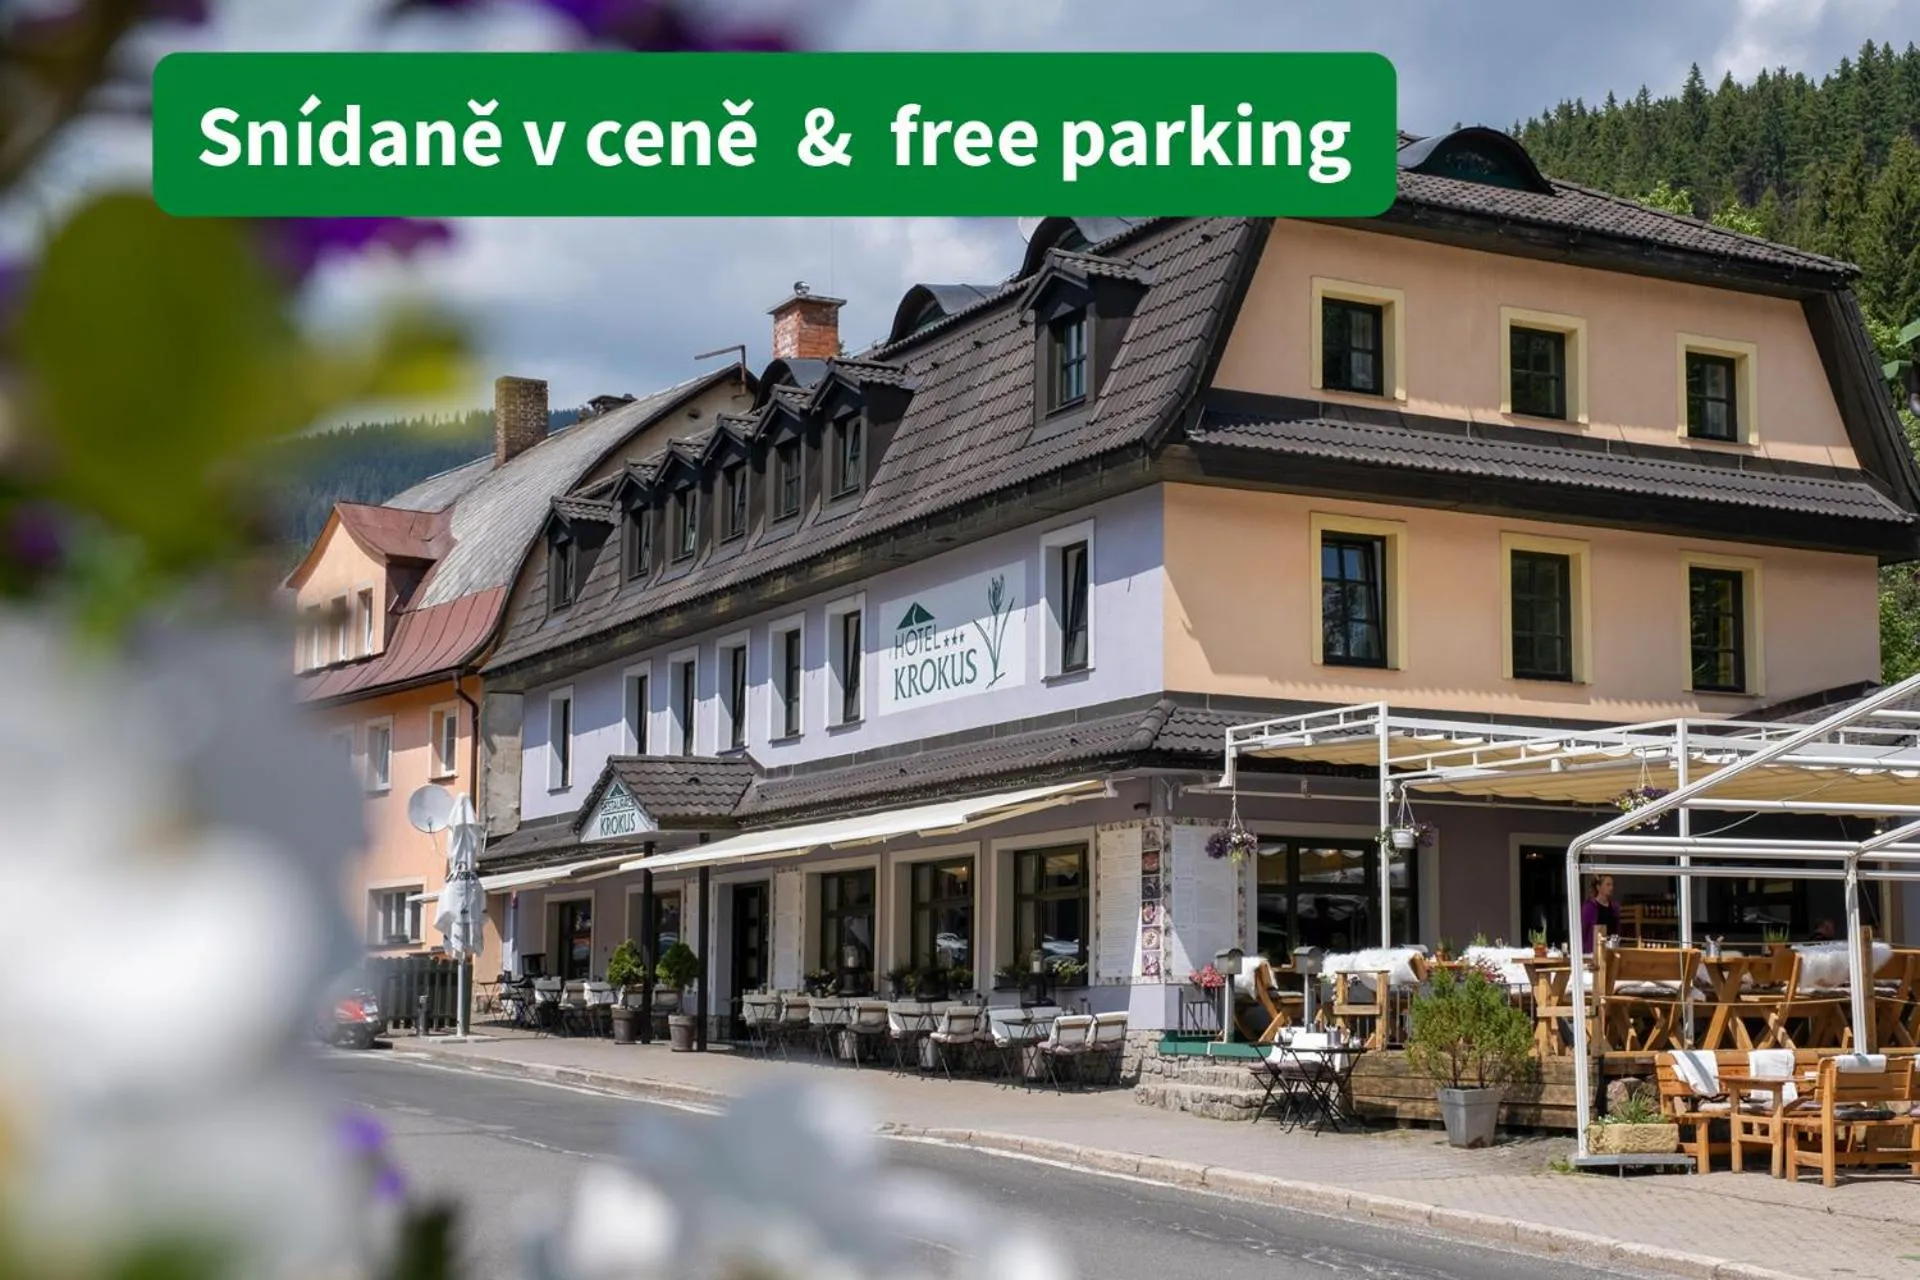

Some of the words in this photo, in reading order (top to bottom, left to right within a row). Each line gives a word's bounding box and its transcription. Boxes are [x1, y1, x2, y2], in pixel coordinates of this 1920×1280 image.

[894, 624, 941, 659] HOTEL
[894, 648, 978, 700] KROKUS
[600, 813, 636, 836] KROKUS
